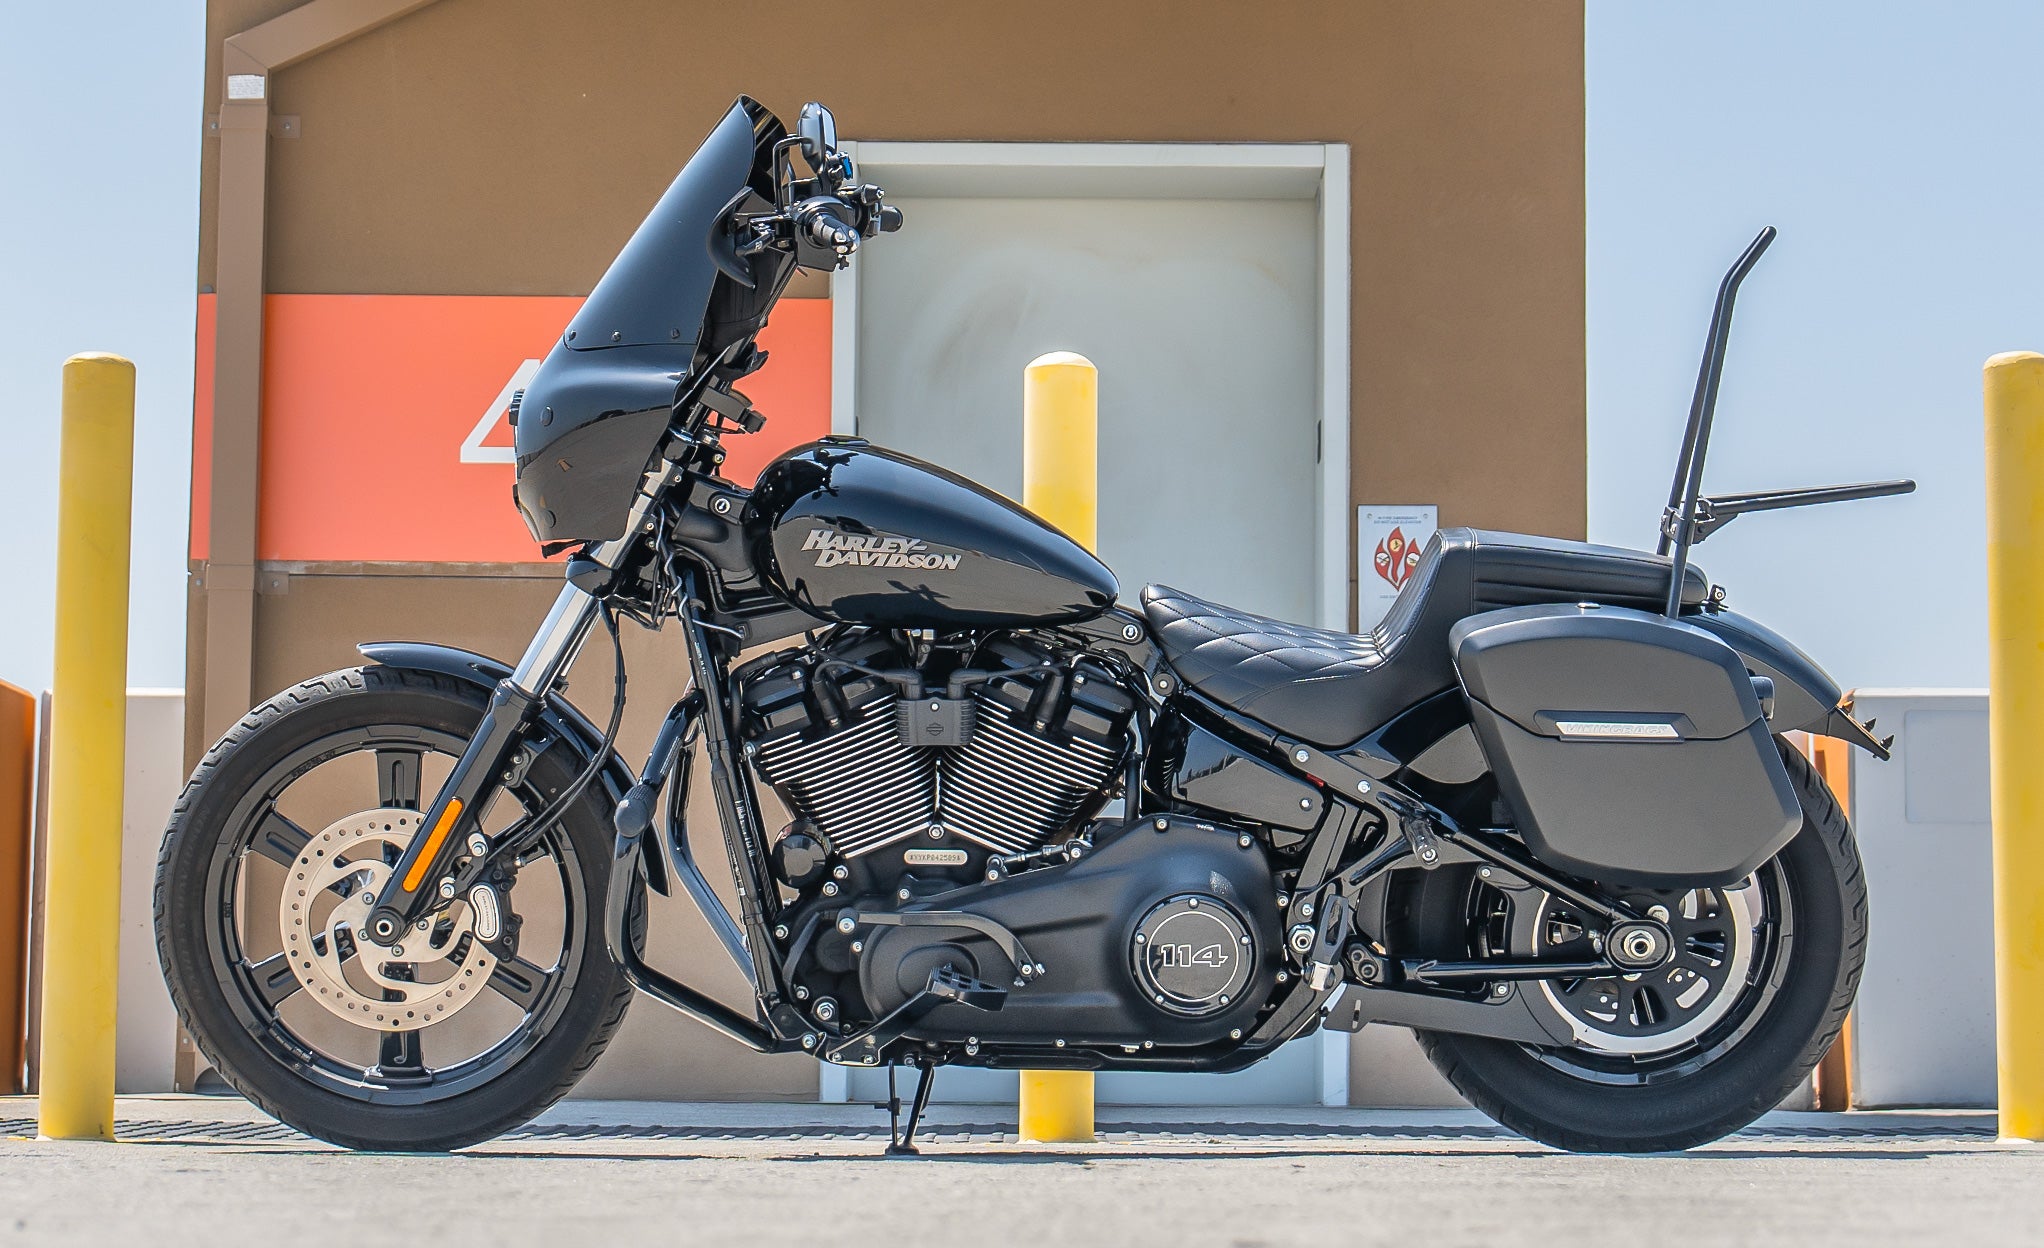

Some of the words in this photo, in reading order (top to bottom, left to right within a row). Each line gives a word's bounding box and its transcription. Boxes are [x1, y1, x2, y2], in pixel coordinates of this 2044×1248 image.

[460, 358, 541, 463] 4
[801, 529, 928, 553] HARLEY-
[814, 549, 962, 570] DAVIDSON
[1161, 944, 1228, 967] 114
